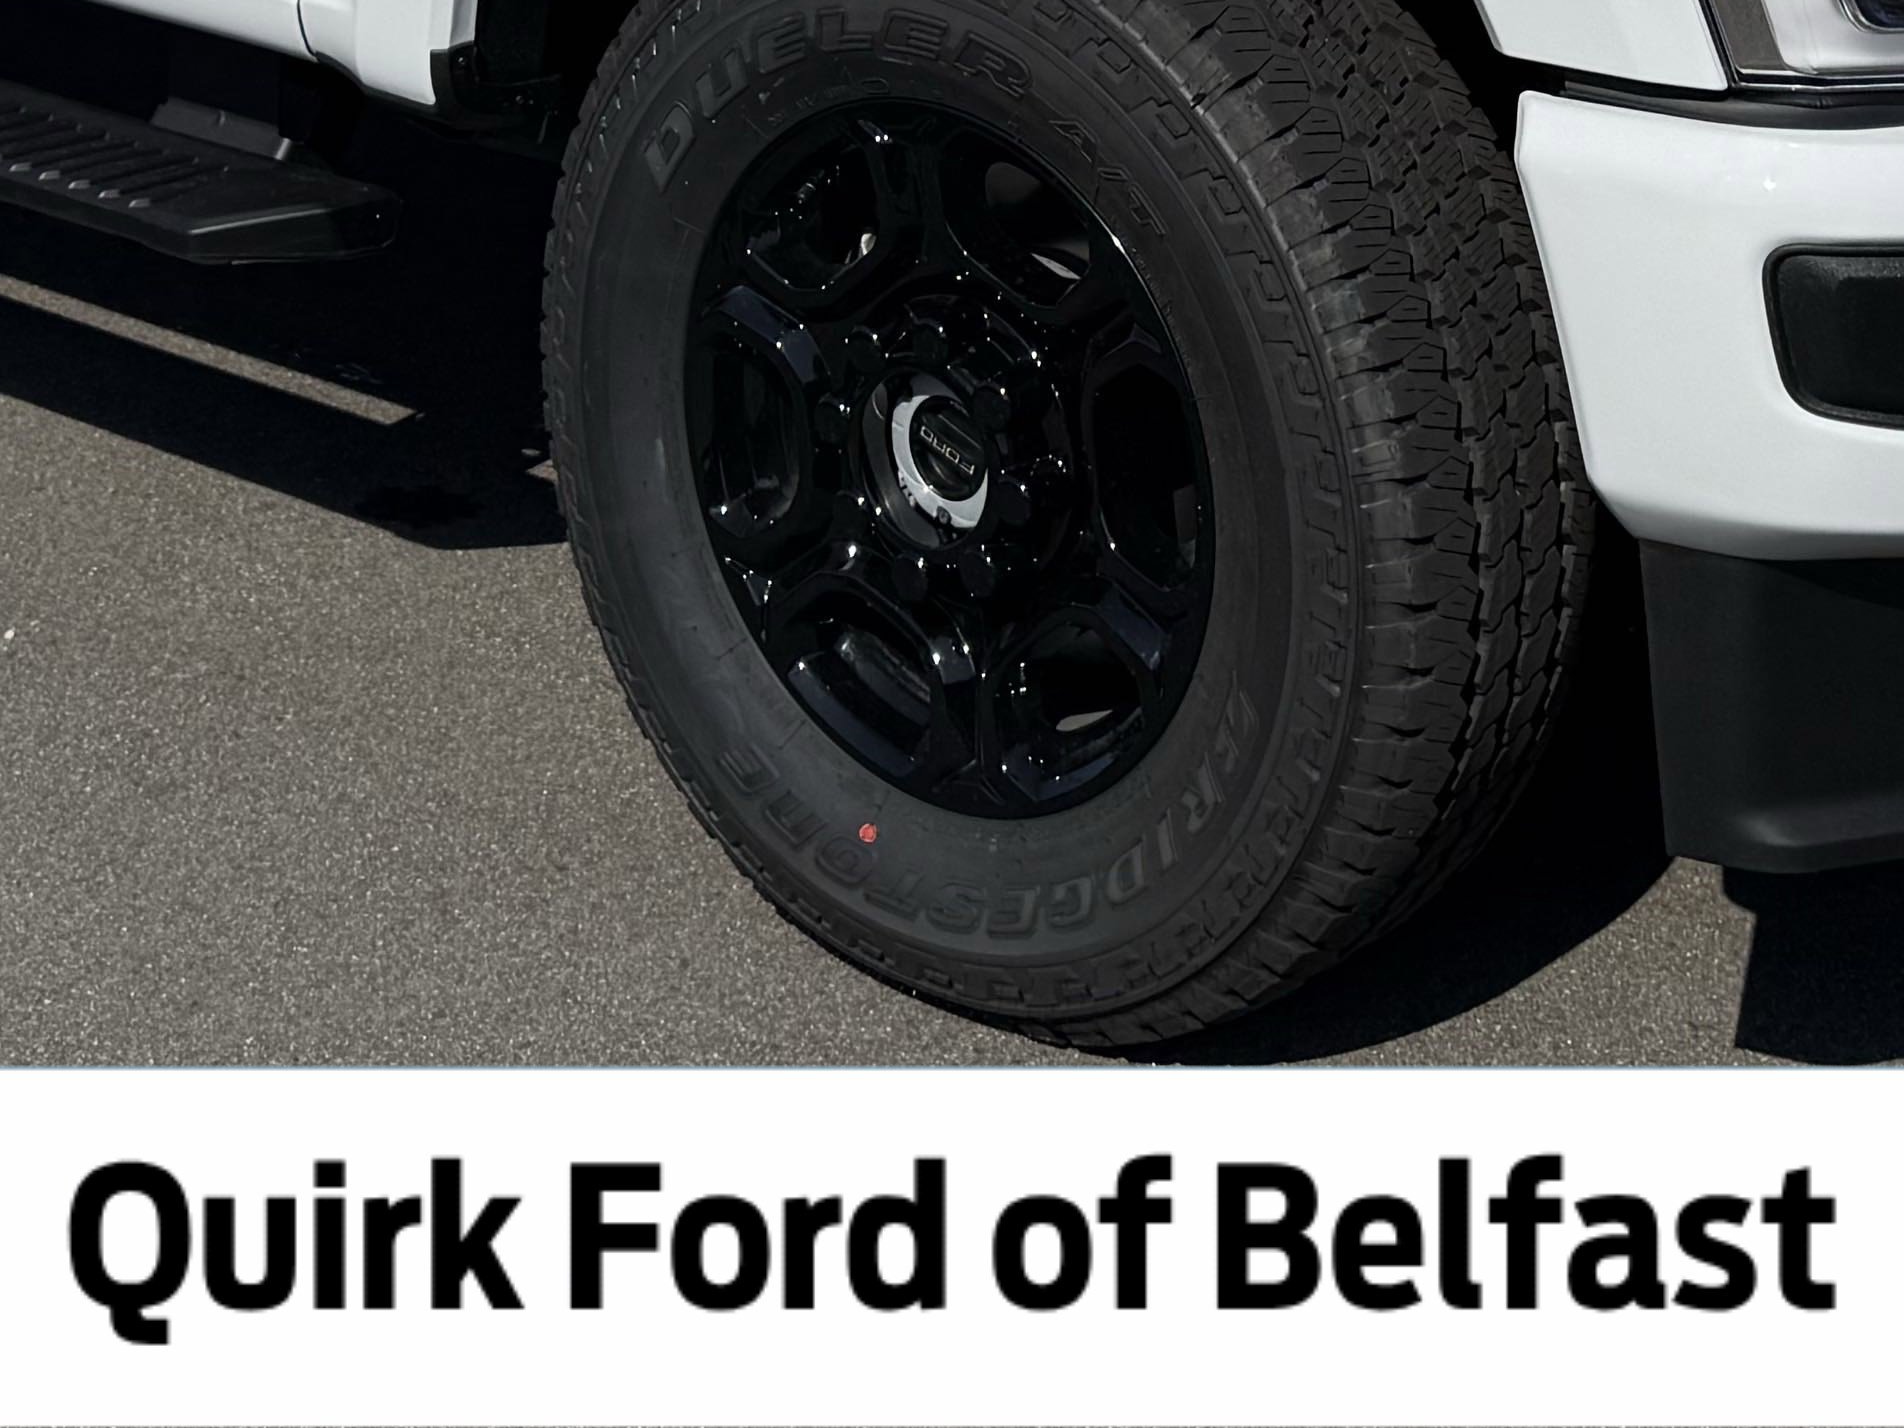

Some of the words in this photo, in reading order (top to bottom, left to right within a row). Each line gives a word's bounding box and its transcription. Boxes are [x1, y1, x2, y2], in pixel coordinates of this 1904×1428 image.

[643, 5, 1034, 197] DUELER
[1046, 118, 1169, 238] A/T
[919, 424, 976, 476] FORD
[718, 668, 1261, 938] BRIDGESTONE
